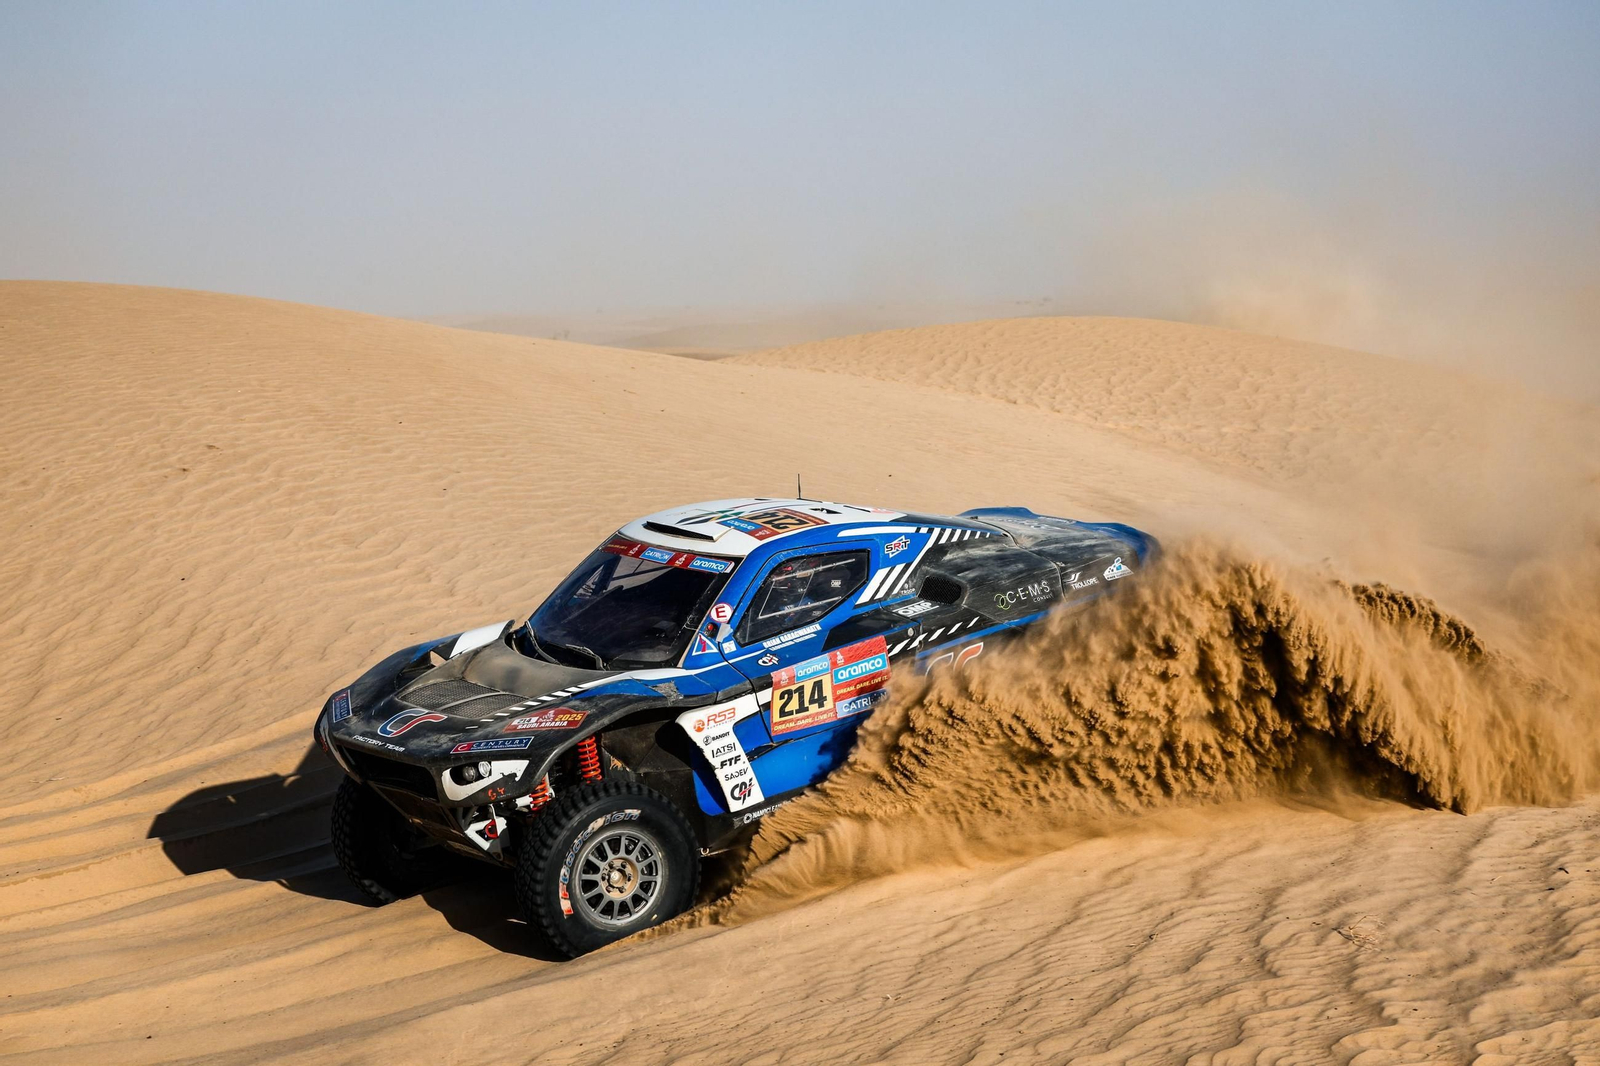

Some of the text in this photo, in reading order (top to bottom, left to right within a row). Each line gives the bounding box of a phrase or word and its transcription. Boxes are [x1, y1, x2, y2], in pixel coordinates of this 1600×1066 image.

[885, 540, 910, 553] SRT
[693, 560, 725, 571] aramco
[1071, 577, 1098, 590] TROLLOPE
[715, 605, 727, 618] E
[897, 601, 932, 616] OMP
[797, 661, 828, 677] aramco
[837, 658, 883, 680] aramco
[778, 679, 827, 718] 214
[555, 713, 583, 722] 2025
[706, 707, 736, 727] R53
[472, 738, 528, 748] CENTURY
[712, 731, 731, 742] BANDIT
[352, 735, 406, 753] FACTORY TEAM
[719, 755, 742, 770] FTF
